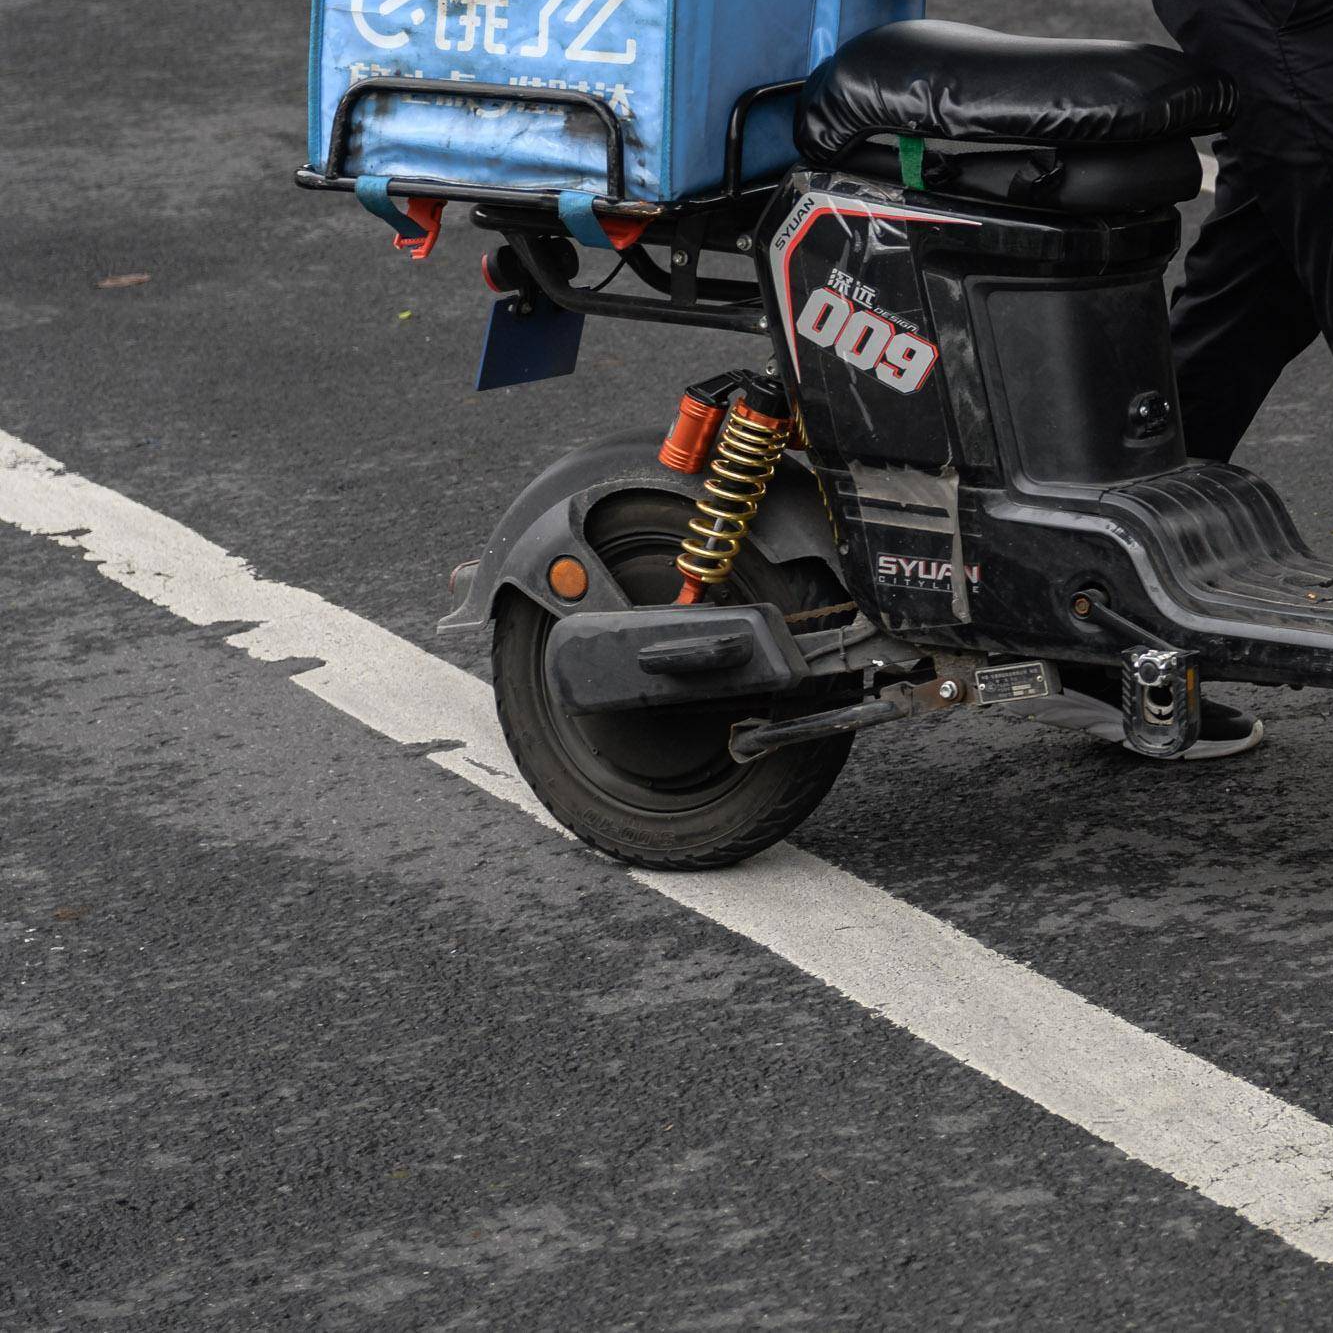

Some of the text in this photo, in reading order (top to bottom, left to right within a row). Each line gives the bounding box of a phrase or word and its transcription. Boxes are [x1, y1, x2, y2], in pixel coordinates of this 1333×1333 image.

[775, 197, 815, 251] SYUAN
[827, 267, 877, 310] 深远
[796, 286, 940, 395] 009
[873, 306, 921, 333] DESIGN
[877, 574, 981, 594] CITYLIE
